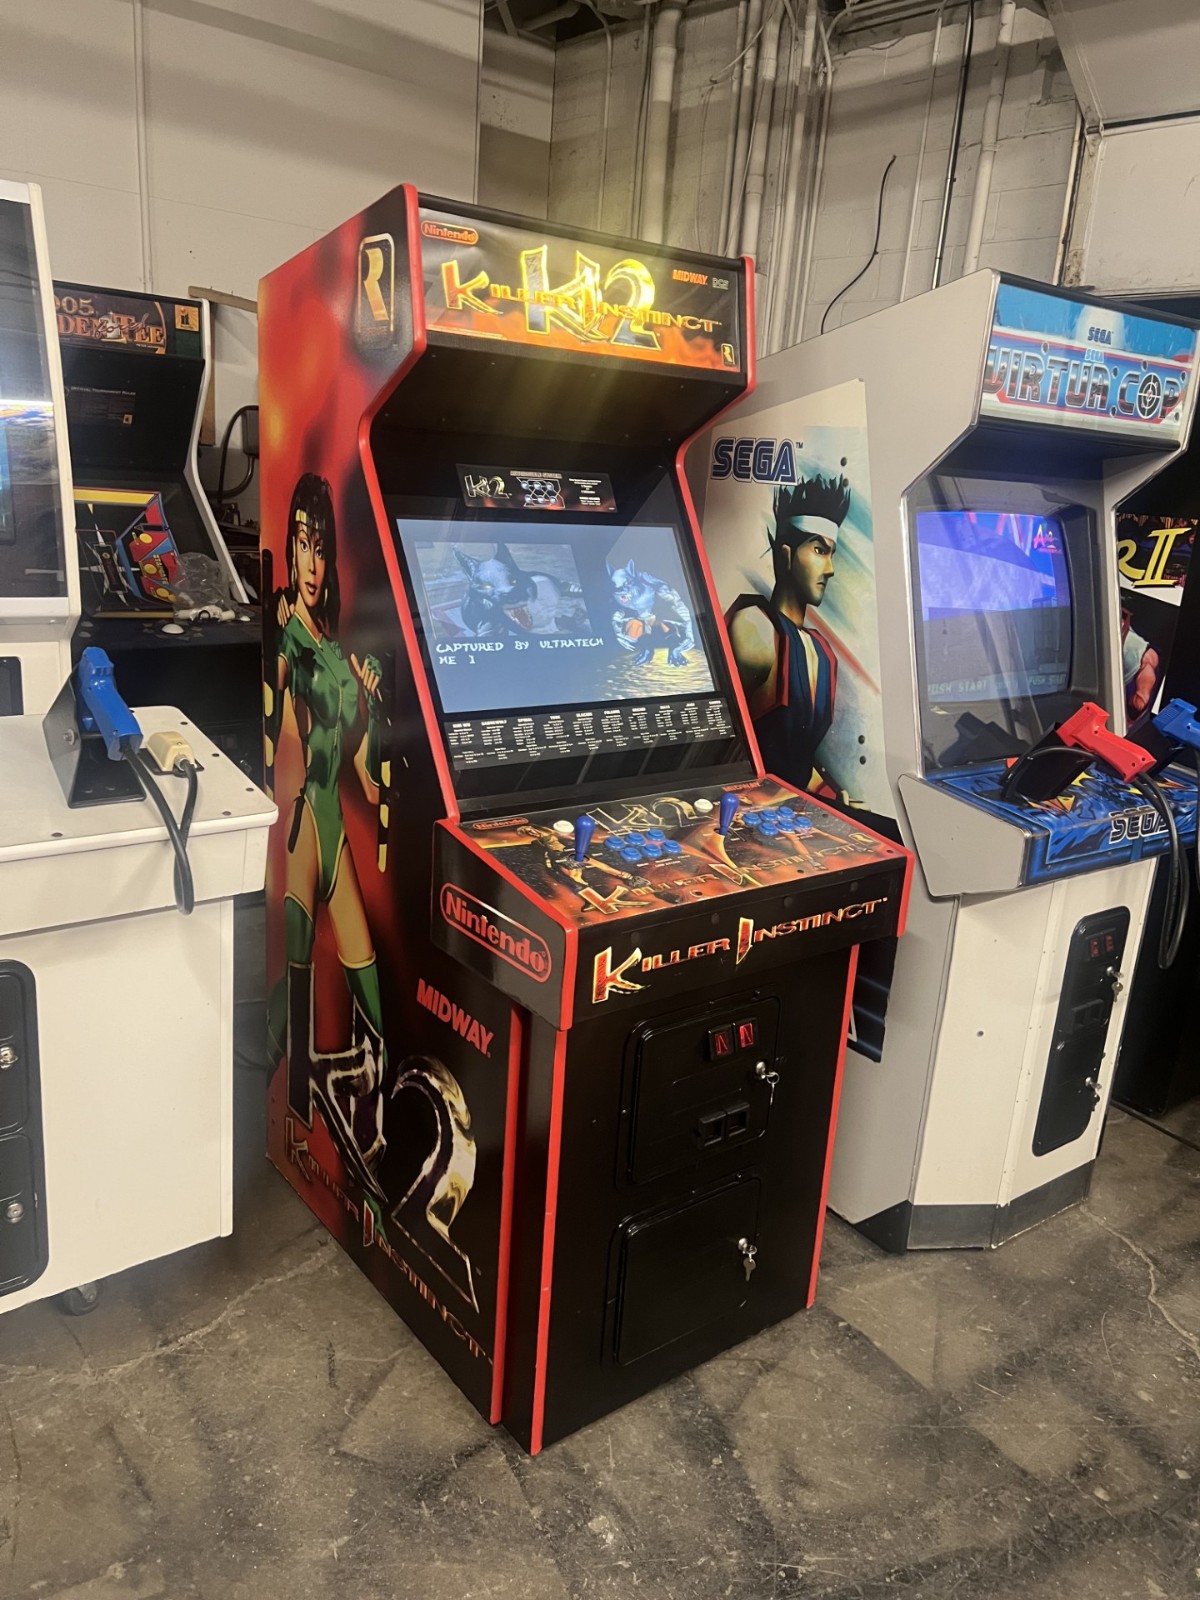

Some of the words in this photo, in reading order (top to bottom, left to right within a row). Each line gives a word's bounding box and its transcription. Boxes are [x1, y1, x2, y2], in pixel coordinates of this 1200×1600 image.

[423, 222, 477, 242] Nintendo
[672, 269, 708, 286] MIDWAY
[1087, 326, 1112, 345] SEGA
[982, 346, 1111, 410] VIRTUA
[1117, 371, 1182, 420] COP
[711, 437, 798, 486] SEGA
[436, 640, 504, 654] CAPTURED
[514, 640, 530, 651] BY
[539, 637, 604, 649] ULTRATECH
[958, 680, 987, 692] START
[445, 890, 547, 973] Nintendo
[592, 937, 731, 1004] KILLER
[736, 897, 884, 966] INSTINCT
[416, 977, 495, 1058] MIDWAY
